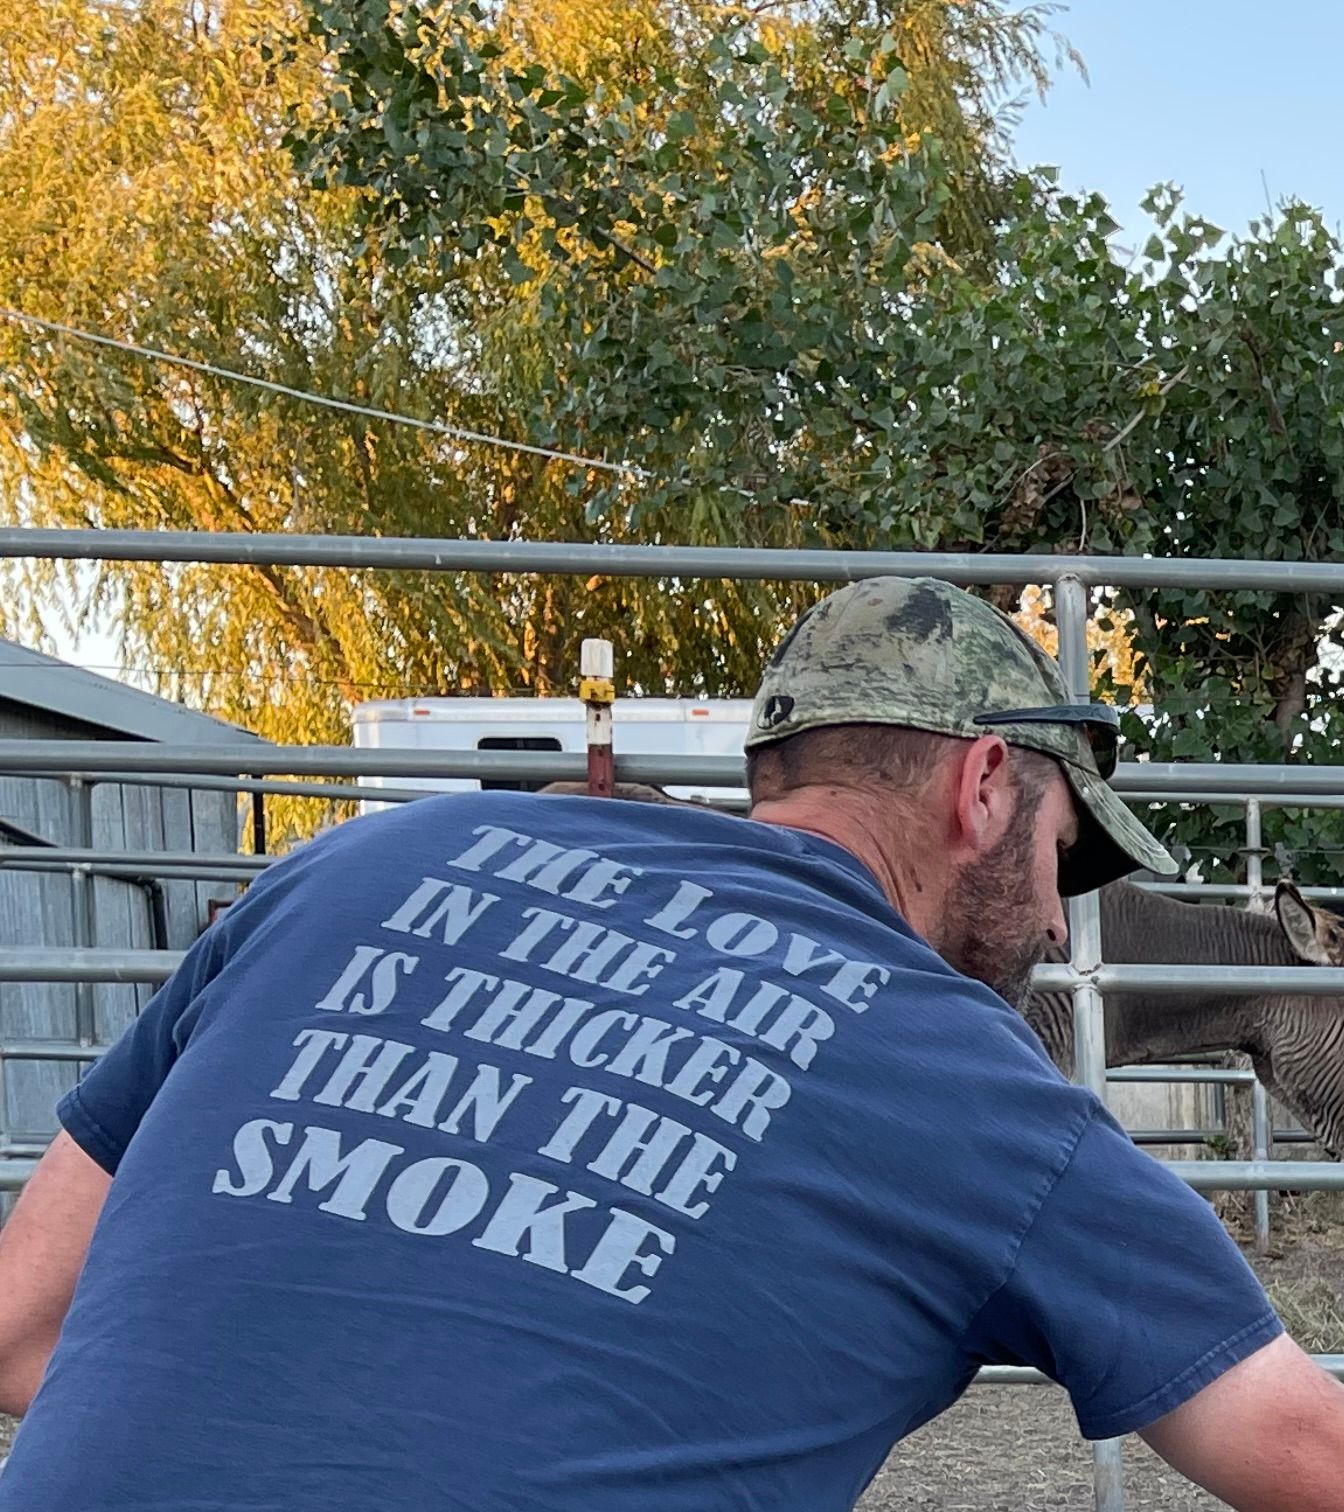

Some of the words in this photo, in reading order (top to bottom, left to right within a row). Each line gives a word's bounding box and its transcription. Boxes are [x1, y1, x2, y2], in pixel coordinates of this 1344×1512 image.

[381, 877, 500, 945] IN
[499, 908, 676, 996] THE
[673, 967, 836, 1071] AIR
[446, 825, 643, 908] THE
[644, 880, 890, 1014] LOVE
[270, 1029, 533, 1143] THAN
[538, 1086, 737, 1220] THE
[315, 945, 418, 1016] IS
[421, 967, 792, 1142] THICKER
[212, 1119, 676, 1304] SMOKE
